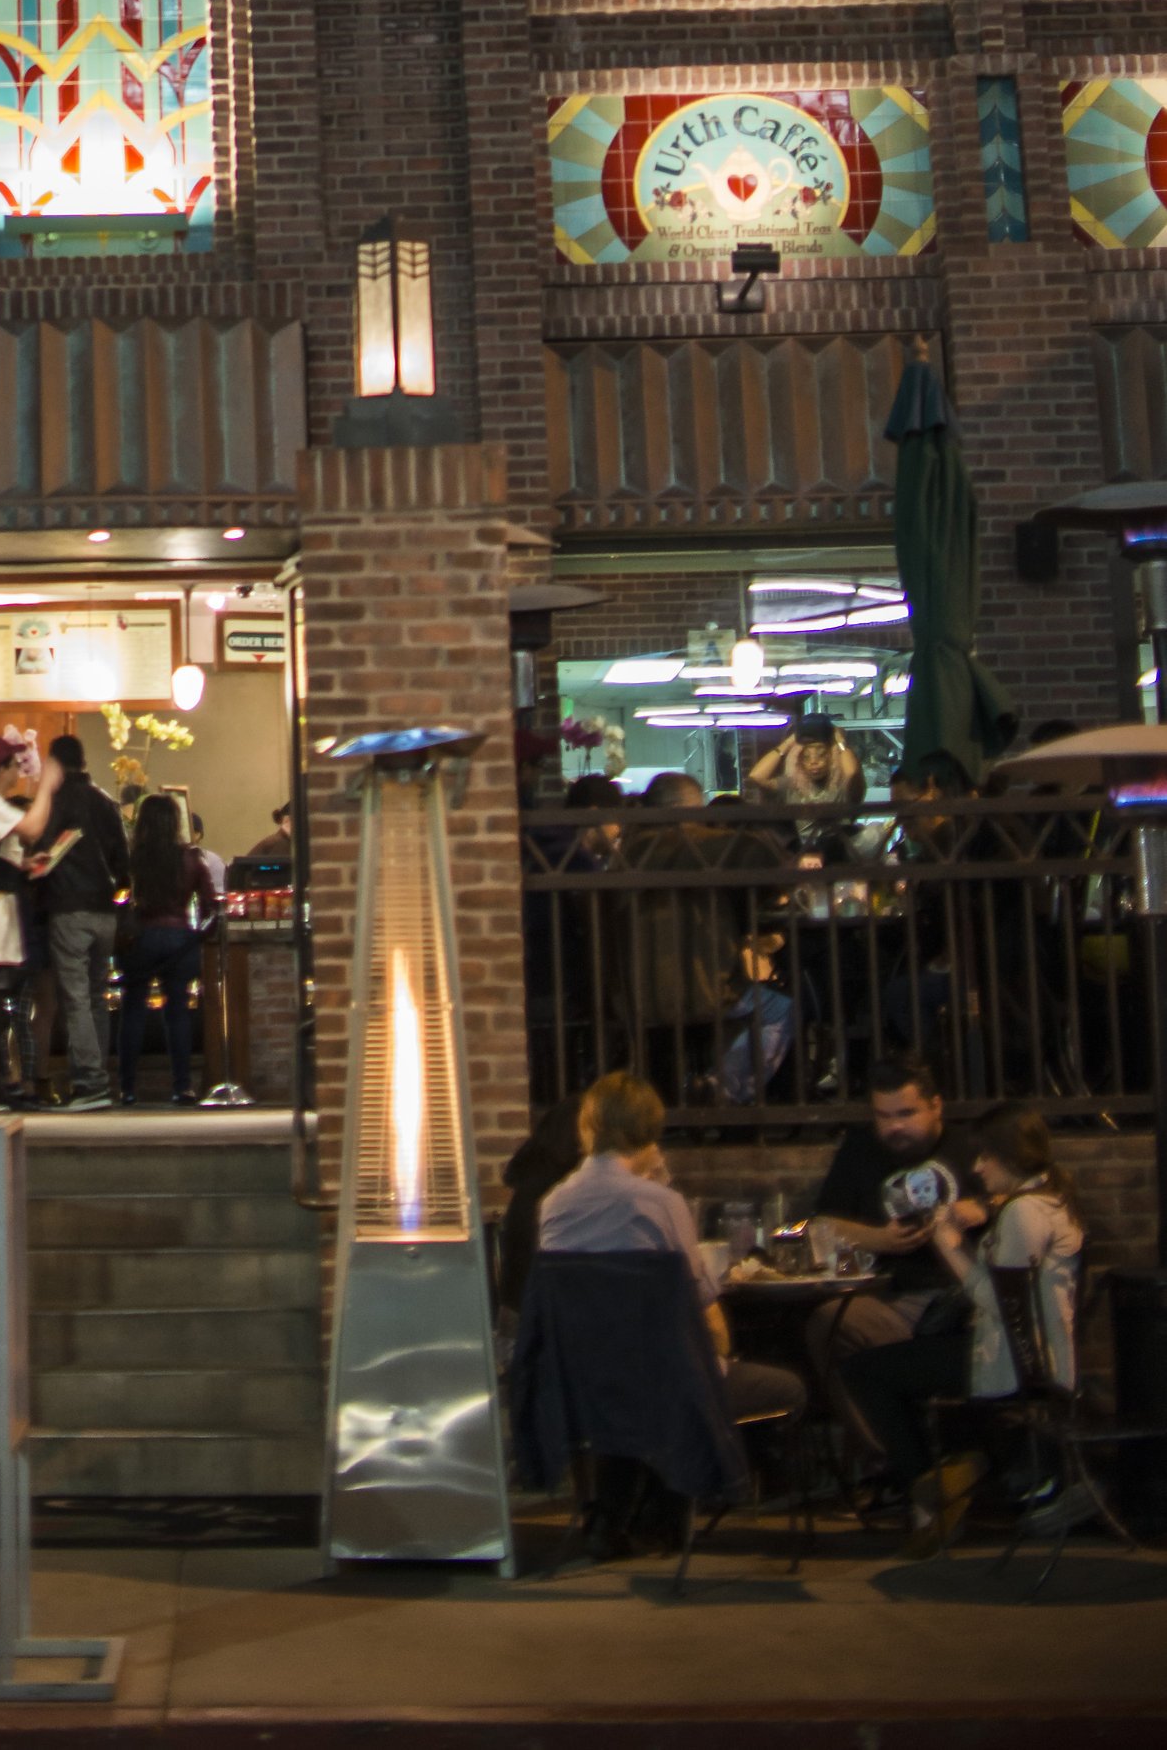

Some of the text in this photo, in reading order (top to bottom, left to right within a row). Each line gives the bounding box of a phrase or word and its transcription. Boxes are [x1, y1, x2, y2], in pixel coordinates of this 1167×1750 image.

[654, 105, 828, 176] Urth Caffé
[657, 222, 832, 239] World Class Traditional Teas
[683, 242, 732, 259] Organic
[782, 240, 823, 254] Blends
[228, 636, 284, 648] ORDER HER
